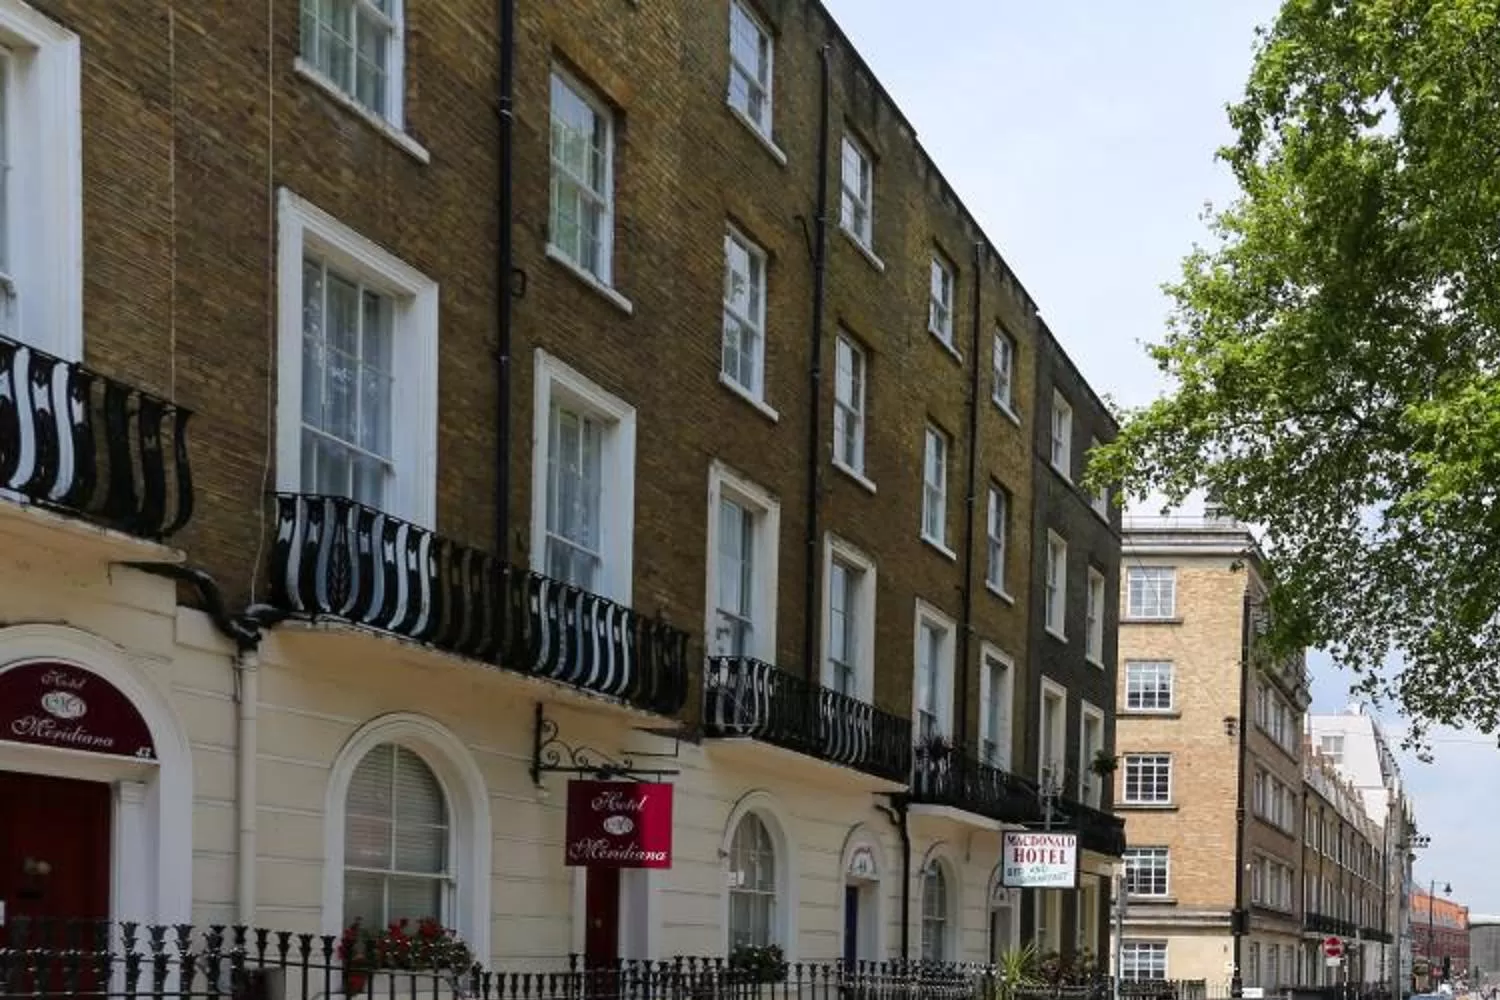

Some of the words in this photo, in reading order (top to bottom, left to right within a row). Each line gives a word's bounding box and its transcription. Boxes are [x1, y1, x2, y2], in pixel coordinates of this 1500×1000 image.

[41, 670, 87, 689] Hotel
[11, 715, 114, 747] Meridiana
[591, 791, 649, 812] Hotel
[568, 838, 668, 861] Meridiana
[1007, 834, 1075, 849] MACDONALD
[1013, 847, 1068, 865] HOTEL
